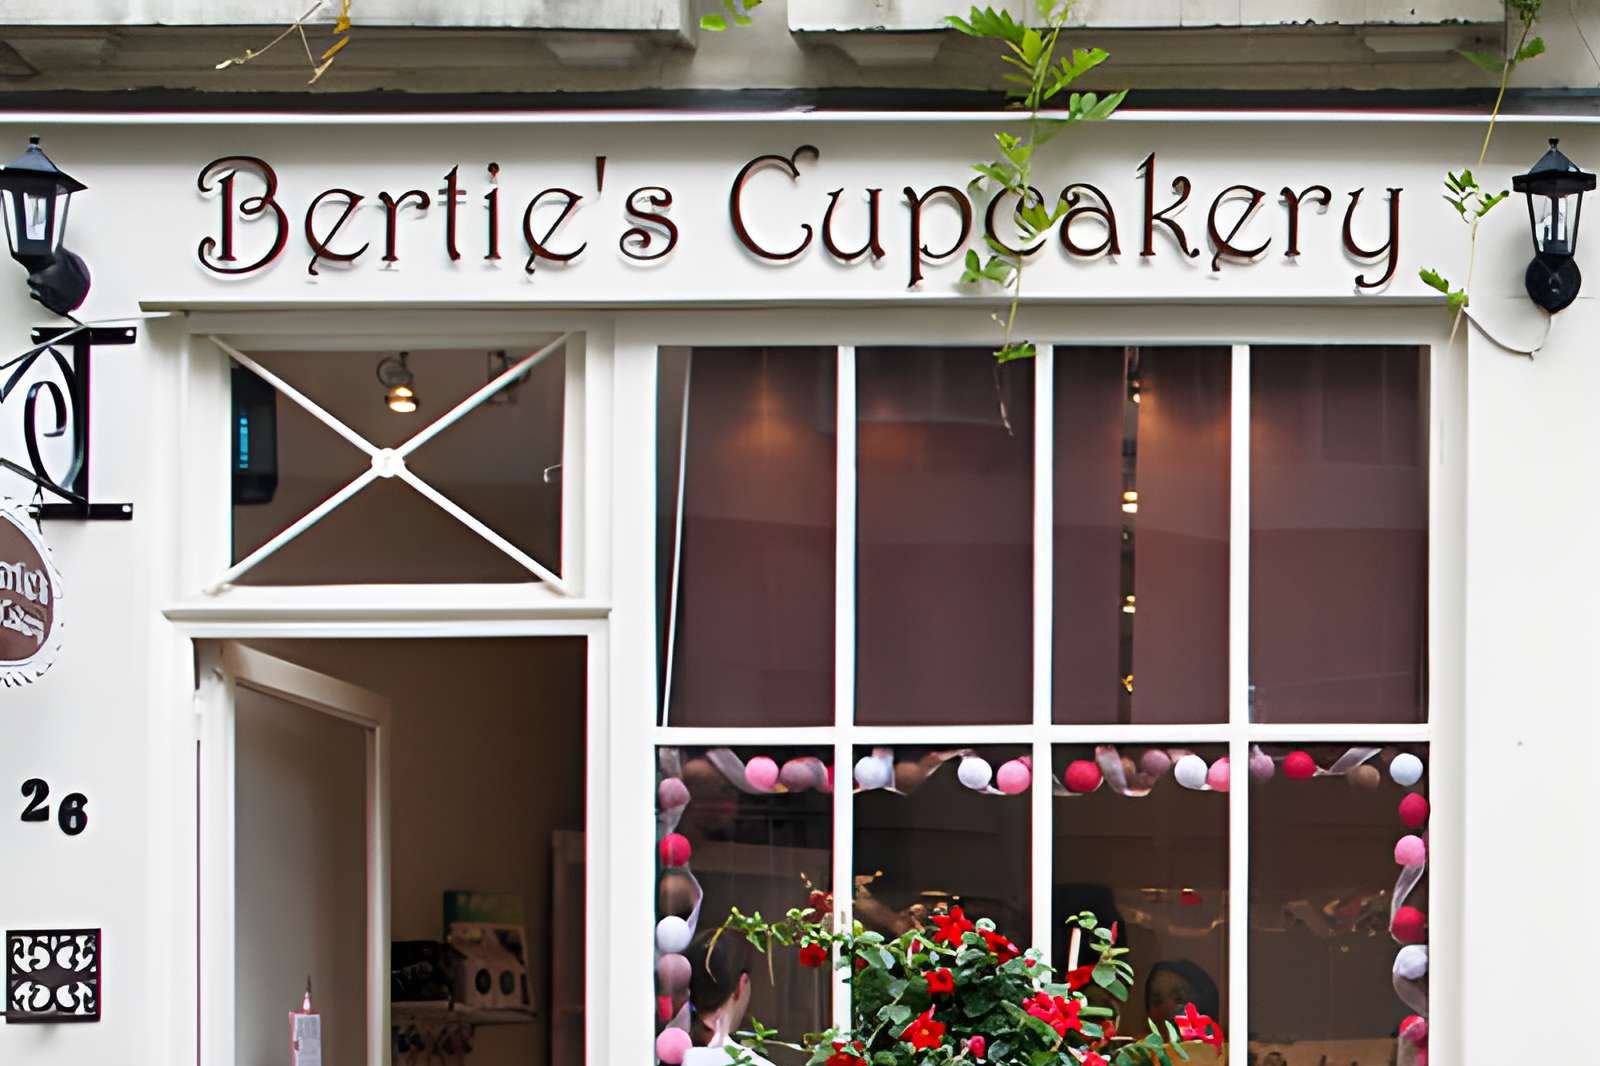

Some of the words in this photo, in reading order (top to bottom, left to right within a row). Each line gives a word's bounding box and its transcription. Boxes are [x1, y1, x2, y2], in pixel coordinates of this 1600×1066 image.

[196, 154, 680, 276] Bertie's
[729, 145, 1404, 291] Cupcakery
[20, 778, 88, 836] 26
